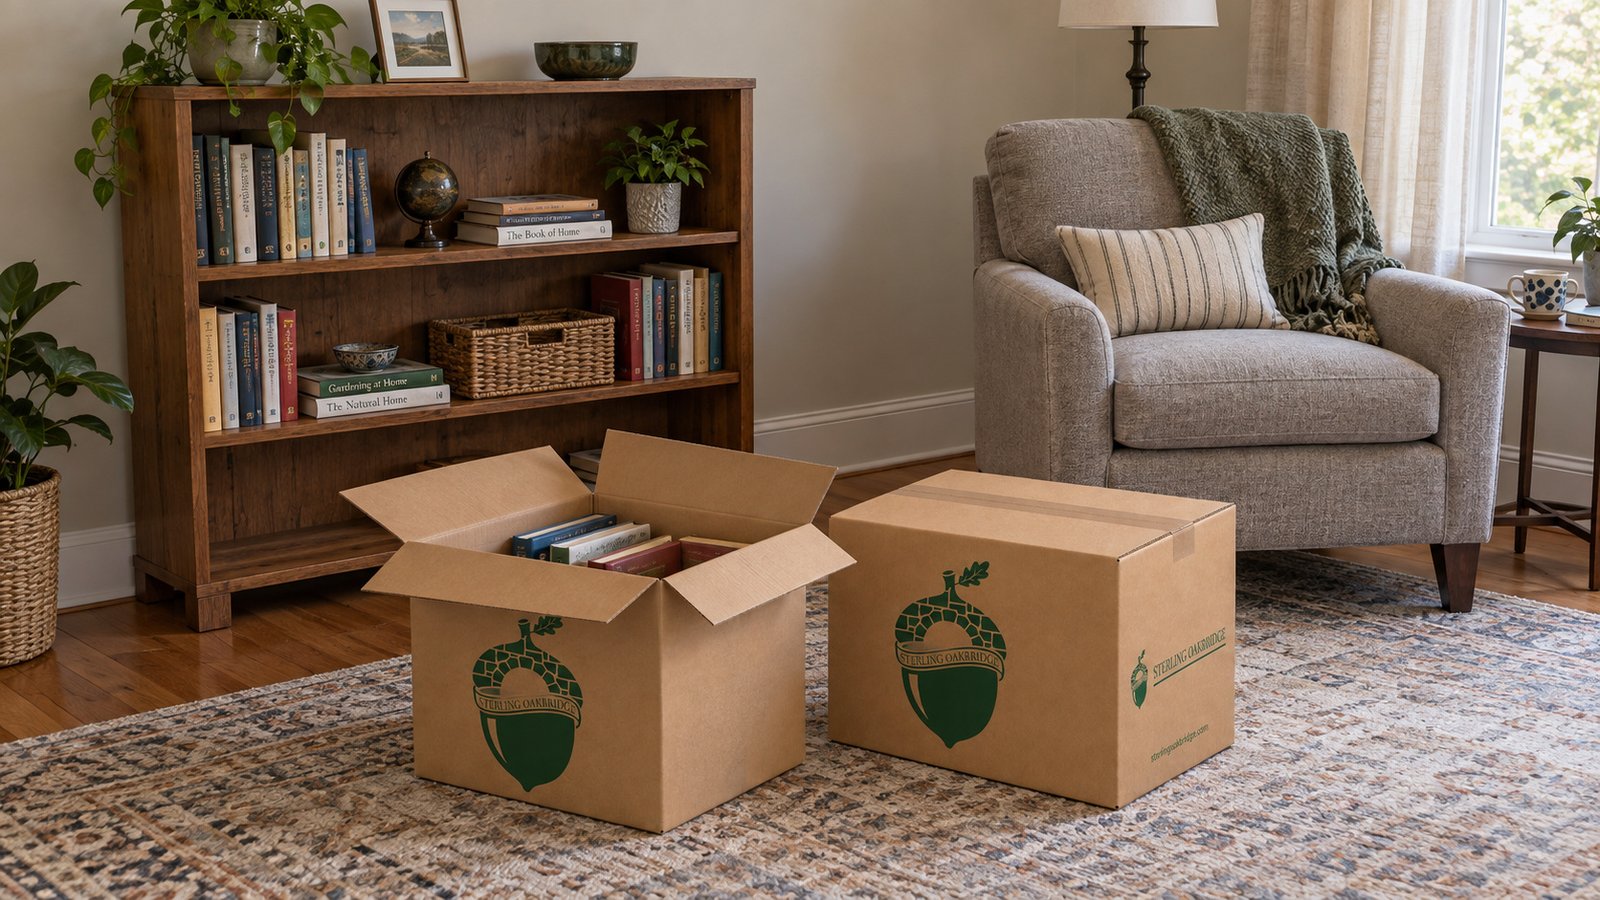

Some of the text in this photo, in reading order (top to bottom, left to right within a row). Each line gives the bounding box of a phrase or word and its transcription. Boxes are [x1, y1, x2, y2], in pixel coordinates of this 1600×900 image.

[507, 228, 580, 240] The Book of Home
[328, 383, 372, 393] Gardening
[383, 378, 407, 386] Home
[326, 396, 407, 412] The Natural Home
[899, 651, 998, 667] STERLING OAKBRIDGE
[1152, 648, 1187, 679] STERLING
[479, 697, 576, 715] STERLING OAKBRIDGE
